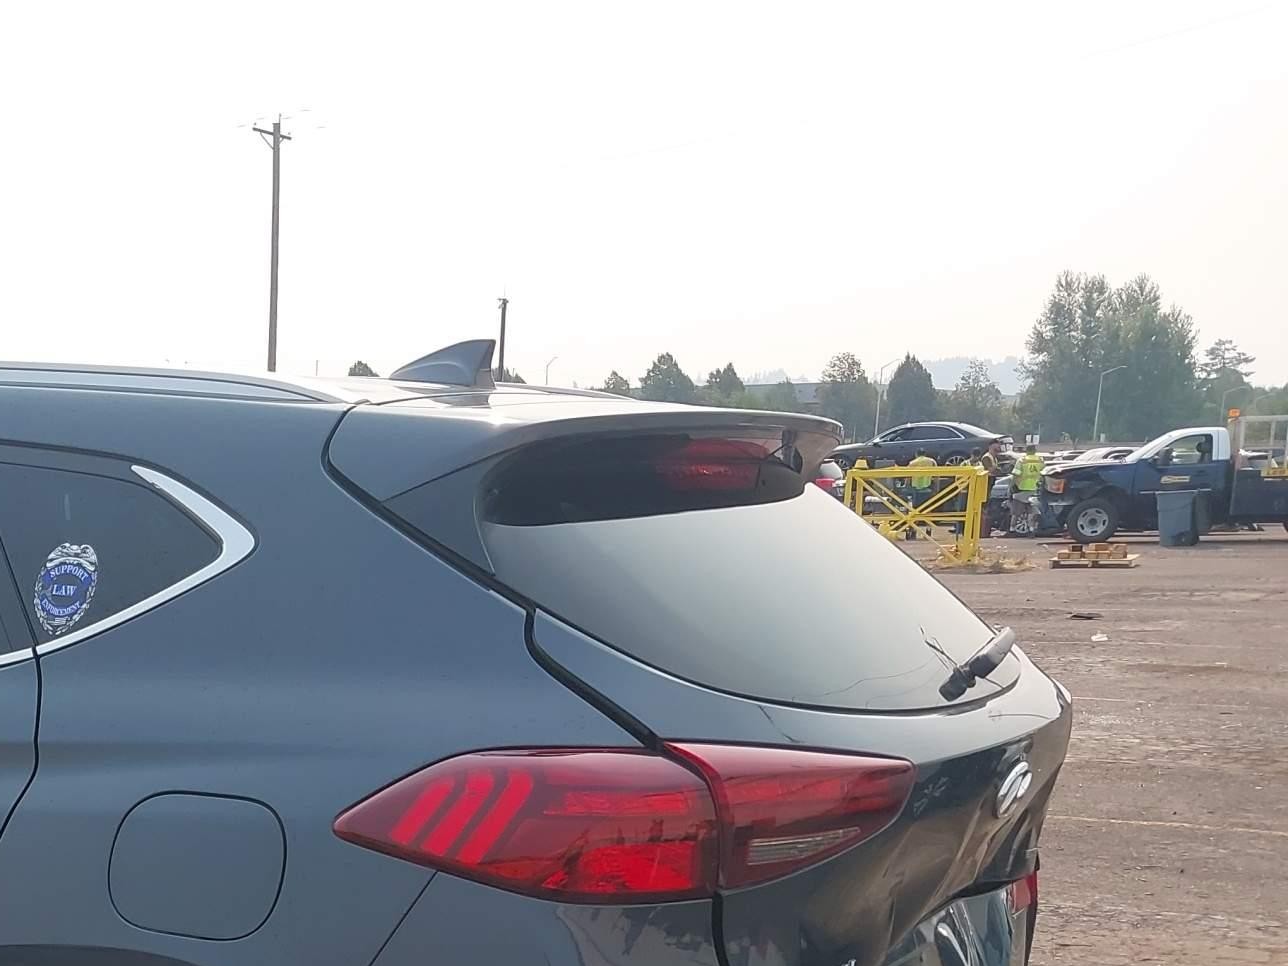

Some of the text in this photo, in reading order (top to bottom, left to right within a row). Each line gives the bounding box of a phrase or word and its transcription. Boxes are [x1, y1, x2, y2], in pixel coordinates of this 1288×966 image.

[49, 564, 89, 582] SUPPORT
[52, 584, 77, 597] LAW
[41, 599, 81, 616] ENFORCEMENT
